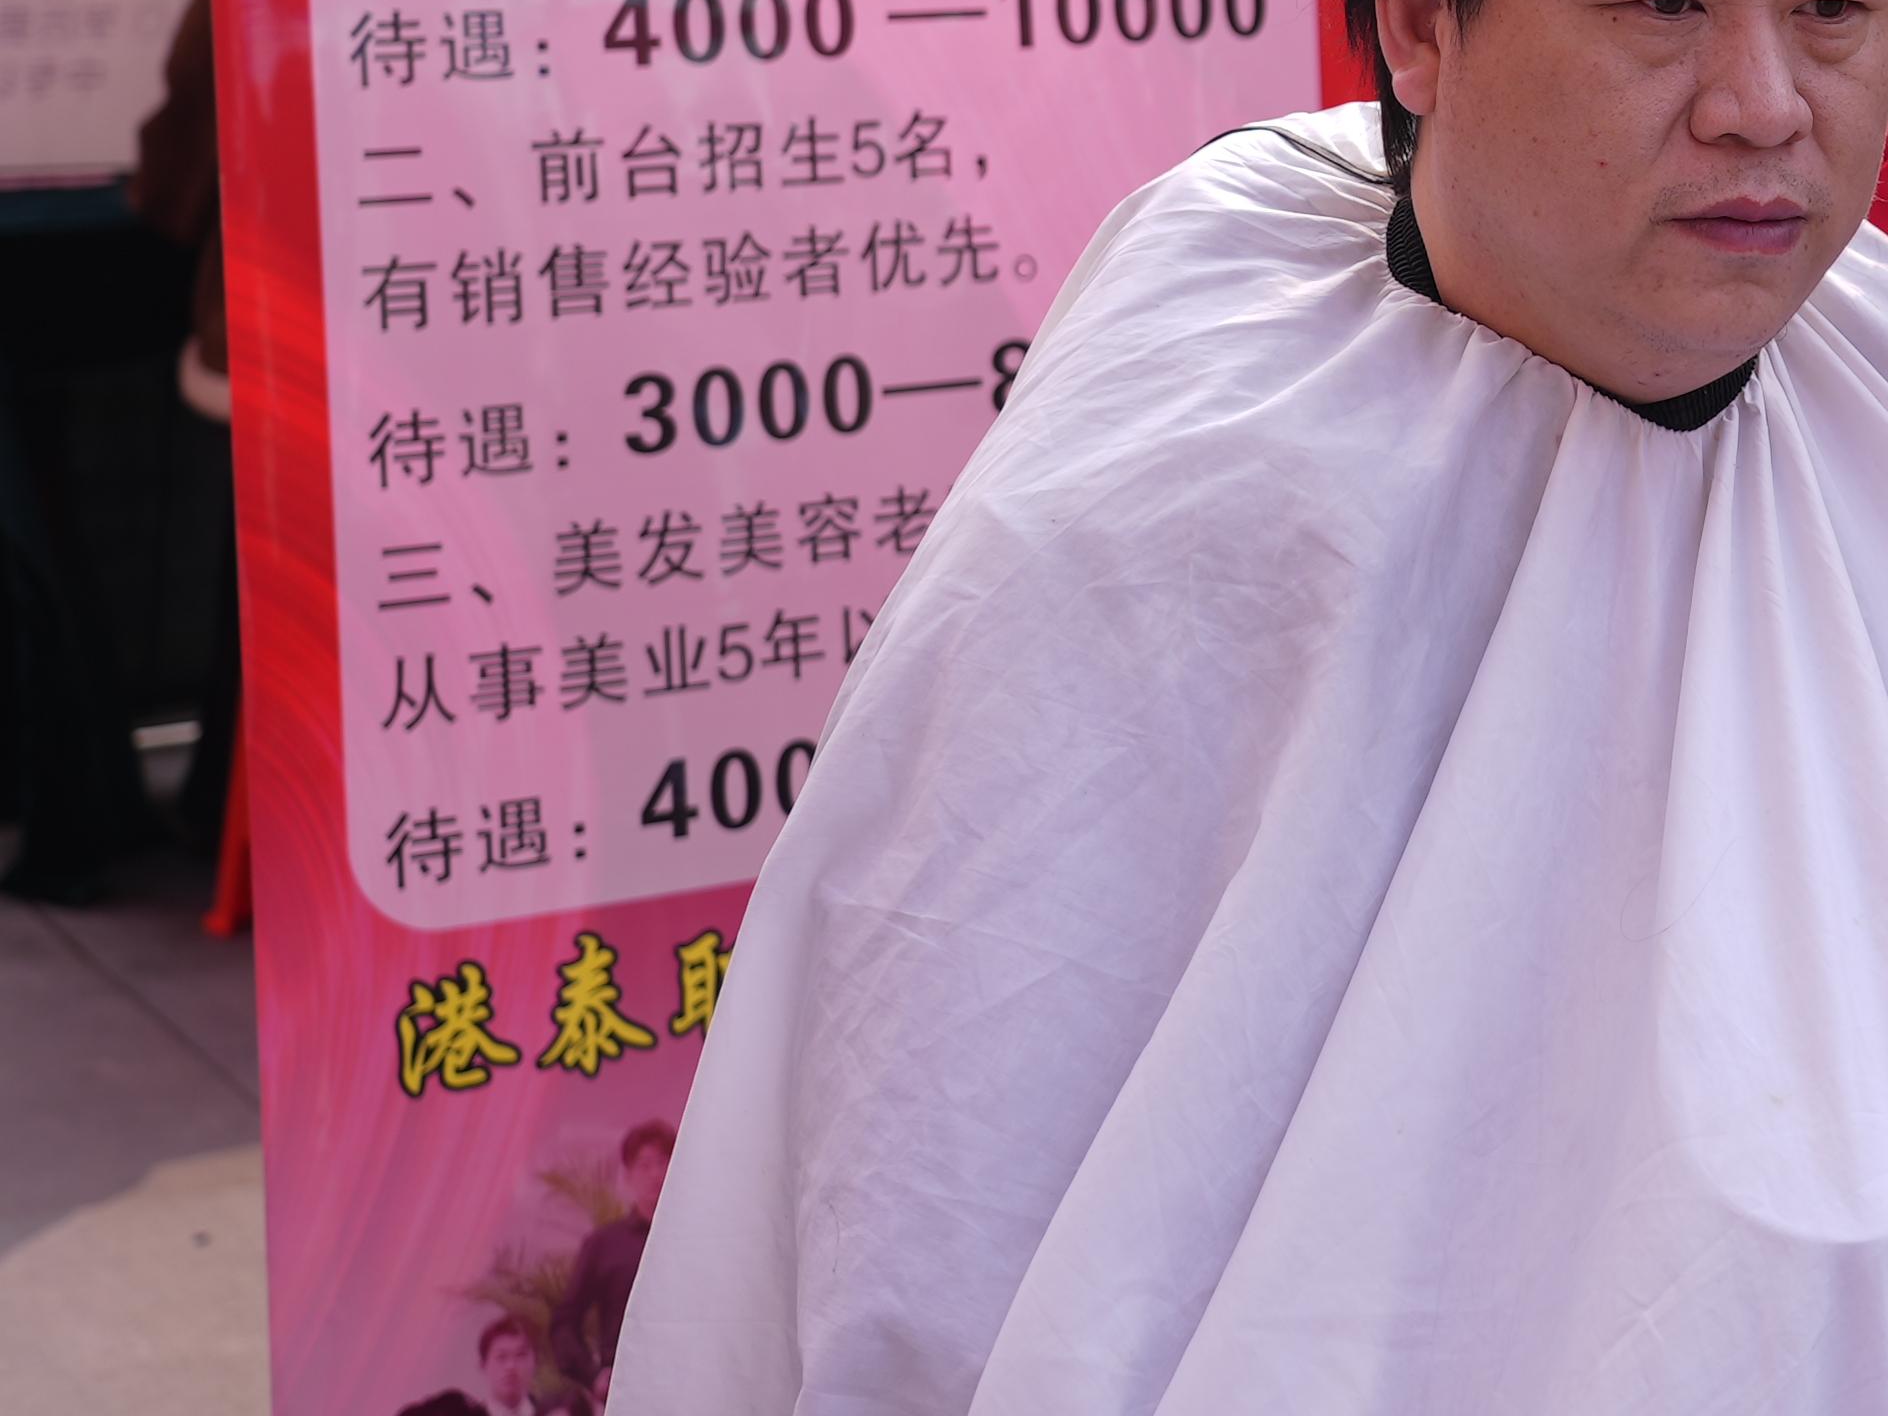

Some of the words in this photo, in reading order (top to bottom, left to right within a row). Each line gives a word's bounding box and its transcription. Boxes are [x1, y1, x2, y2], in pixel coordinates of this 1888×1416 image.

[361, 214, 1039, 333] 有销售经验者优先。
